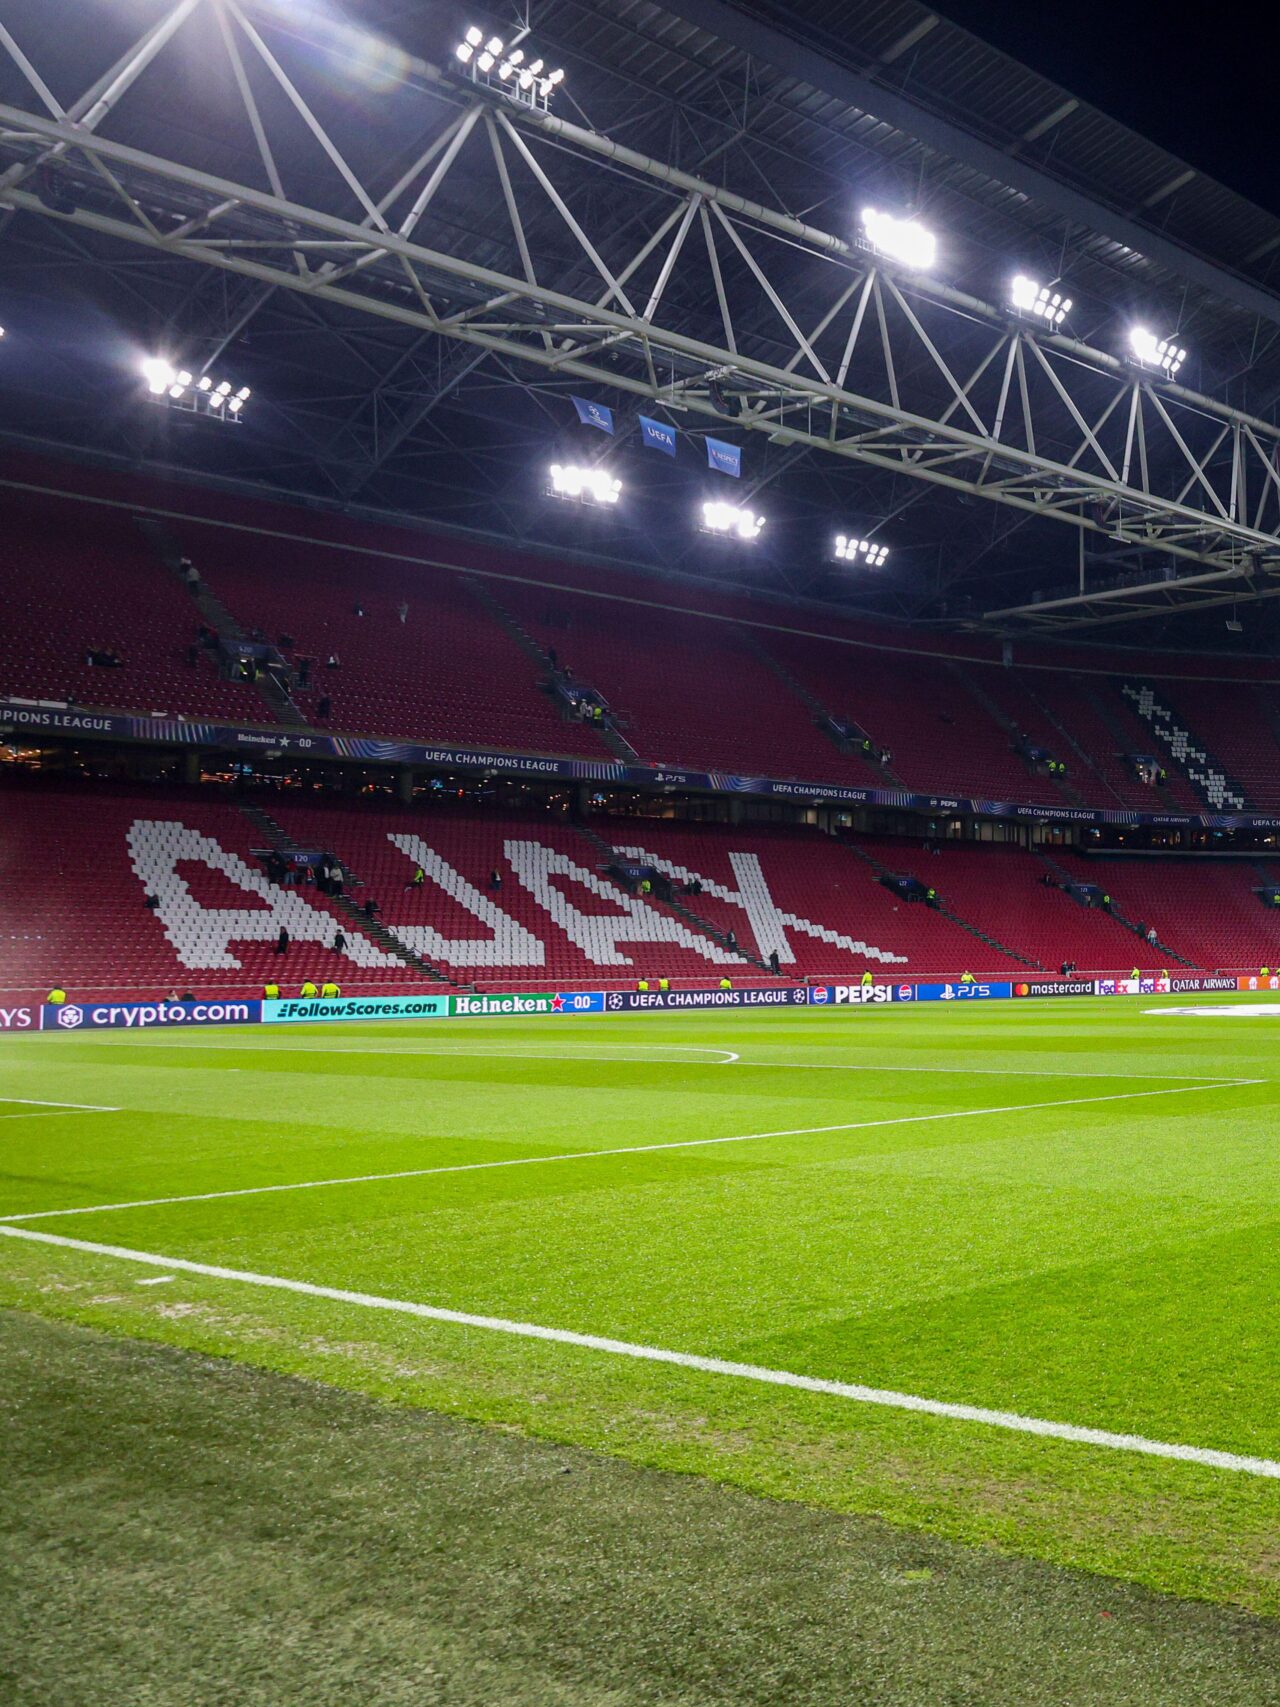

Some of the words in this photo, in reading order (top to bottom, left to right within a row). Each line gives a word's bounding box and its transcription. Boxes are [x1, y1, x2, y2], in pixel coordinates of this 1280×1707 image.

[648, 427, 673, 446] UEFA
[0, 710, 51, 726] PIONS
[54, 715, 113, 731] LEAGUE
[237, 733, 276, 745] Heineken
[425, 751, 453, 762] UEFA
[455, 753, 518, 768] CHAMPIONS
[520, 760, 559, 772] LEAGUE
[665, 775, 686, 783] PS5
[773, 784, 792, 794] UEFA
[793, 786, 838, 798] CHAMPIONS
[838, 790, 867, 800] LEAGUE
[1017, 807, 1032, 816] UEFA
[1033, 808, 1070, 818] CHAMPIONS
[1070, 811, 1095, 820] LEAGUE
[1252, 819, 1270, 827] UEFA
[125, 819, 908, 970] AJAX
[957, 985, 991, 997] PS5
[1031, 981, 1092, 995] mastercard
[1098, 980, 1129, 994] FedEx
[1138, 979, 1167, 993] FedEx
[1172, 979, 1200, 991] QATAR
[1202, 978, 1235, 990] AIRWAYS
[630, 994, 664, 1007] UEFA
[667, 991, 740, 1006] CHAMPIONS
[744, 990, 788, 1004] LEAGUE
[835, 984, 893, 1004] PEPSI
[279, 1001, 438, 1018] FollowScores.com
[455, 996, 548, 1014] Heineken
[0, 1006, 32, 1028] YS
[92, 1002, 249, 1027] crypto.com
